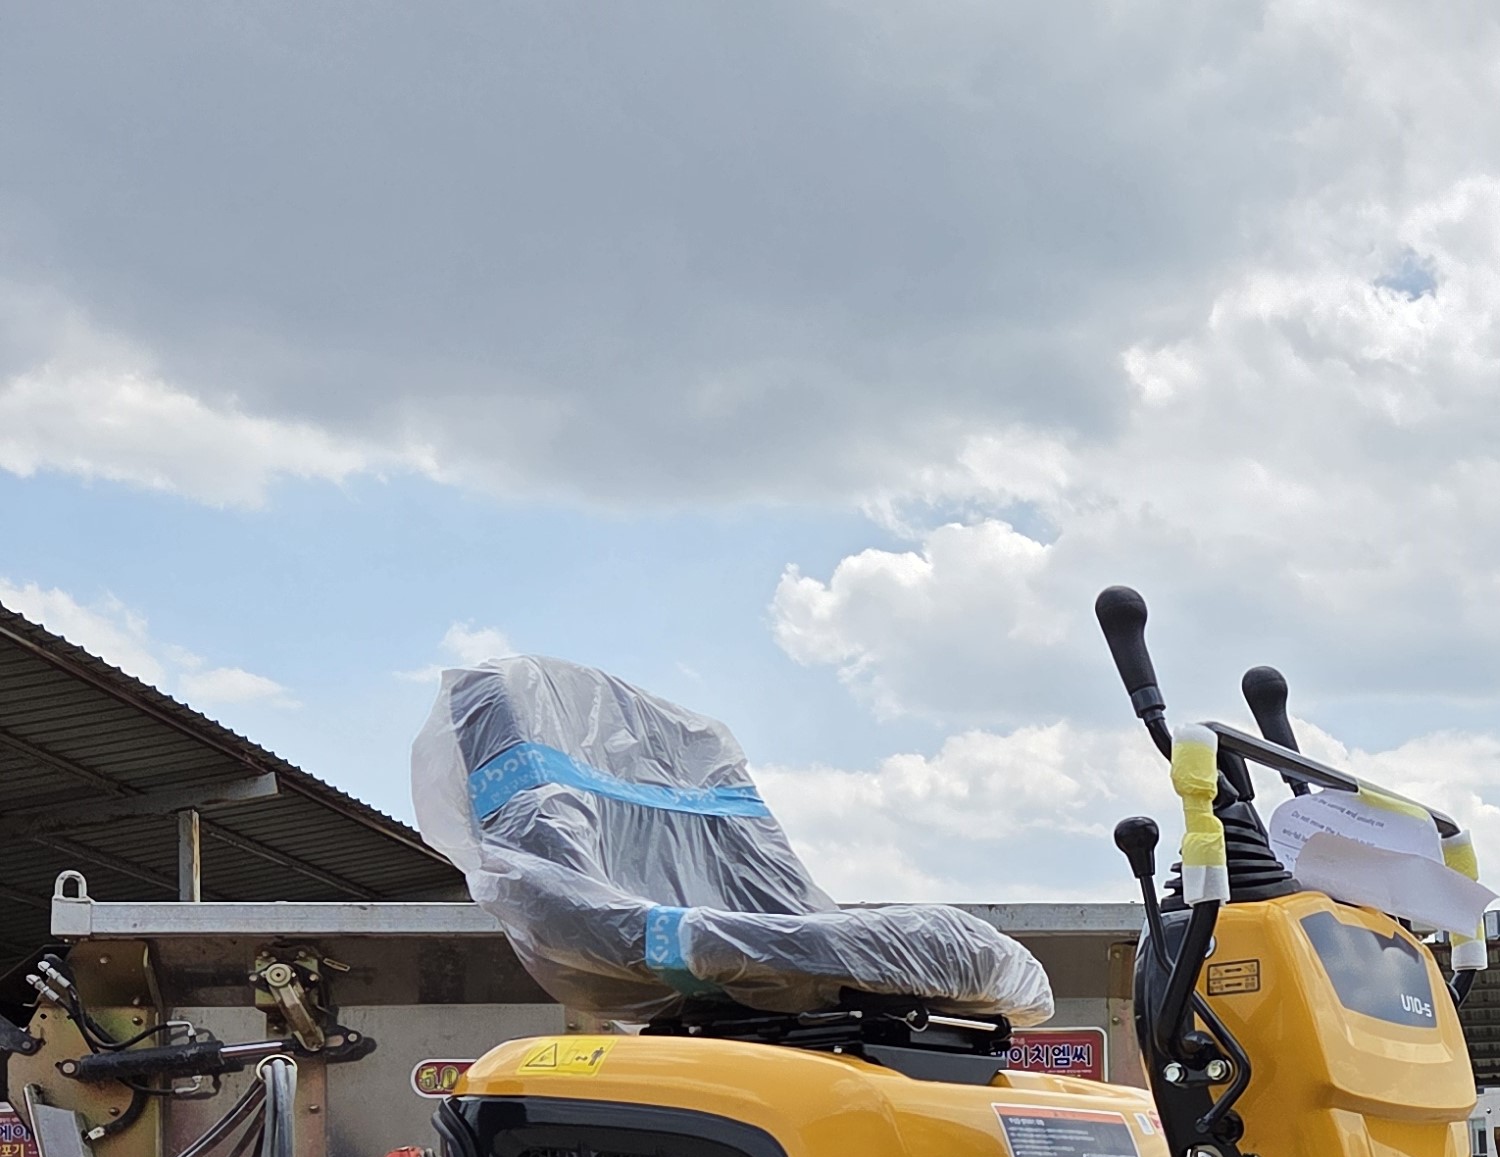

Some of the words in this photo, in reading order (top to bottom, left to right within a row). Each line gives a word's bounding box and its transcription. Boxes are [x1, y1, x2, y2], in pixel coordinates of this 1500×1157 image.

[1400, 993, 1432, 1018] U10-5
[991, 1044, 1093, 1069] 이치엠씨
[0, 1143, 25, 1157] 포기
